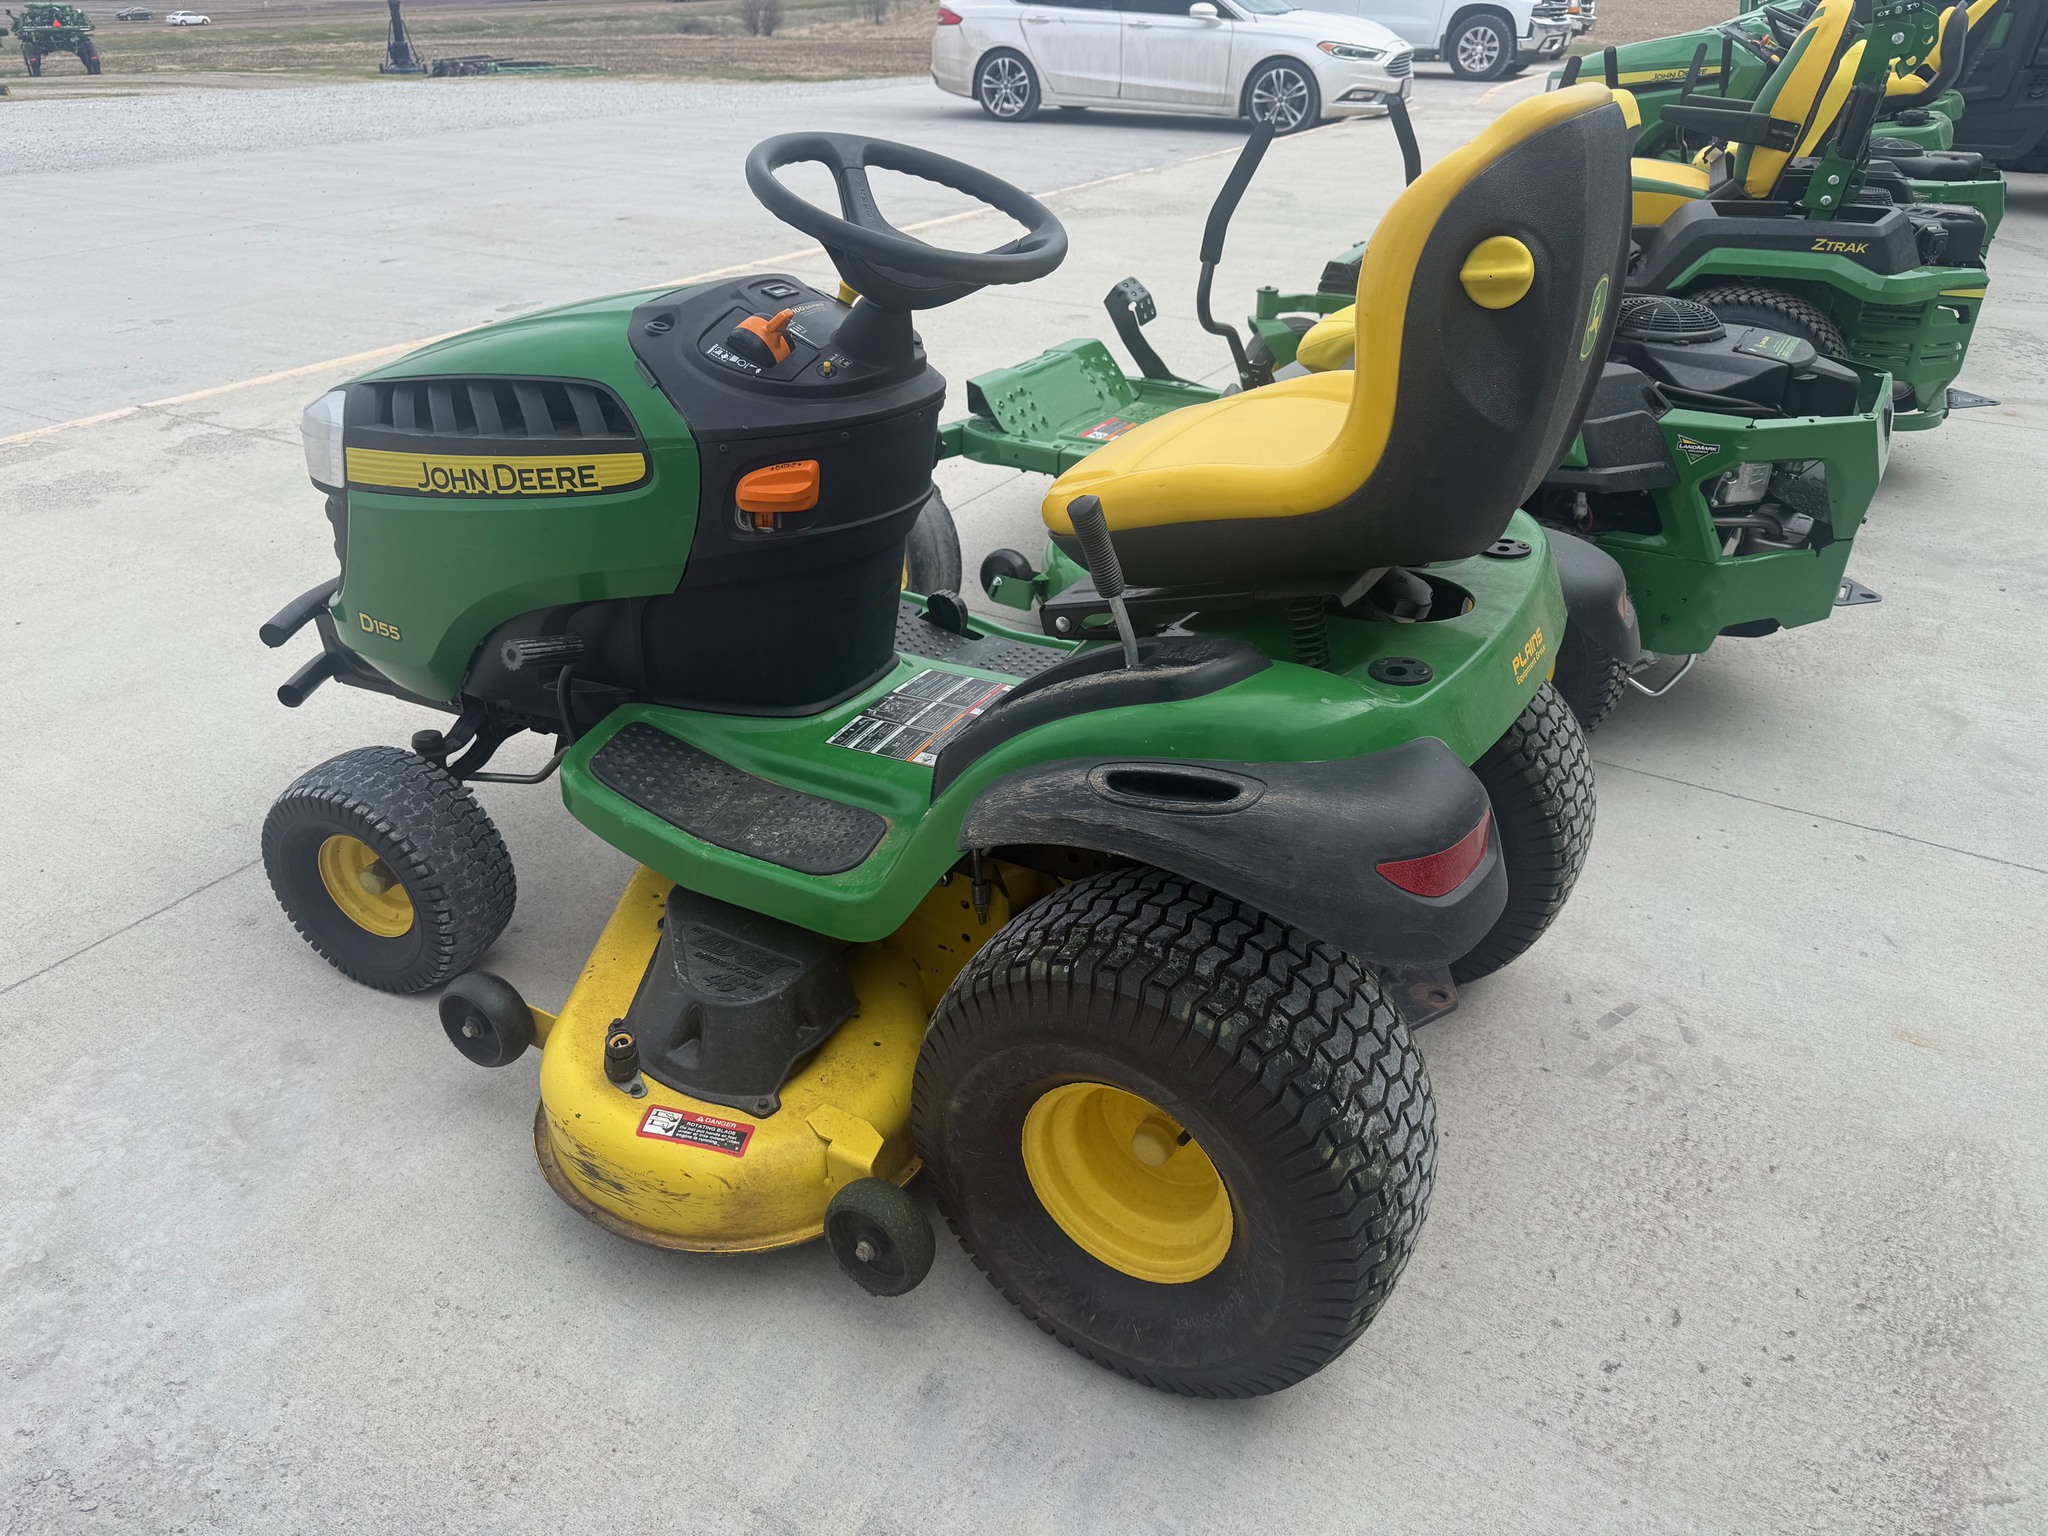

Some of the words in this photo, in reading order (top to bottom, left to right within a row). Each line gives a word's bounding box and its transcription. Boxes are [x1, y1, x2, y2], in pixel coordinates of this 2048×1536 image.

[1651, 71, 1676, 81] JOHN
[1811, 238, 1869, 254] ZTRAK
[418, 461, 489, 491] JOHN
[493, 463, 600, 492] DEERE
[358, 612, 400, 640] D155
[686, 1121, 716, 1131] ROTATING
[705, 1118, 736, 1128] DANGER
